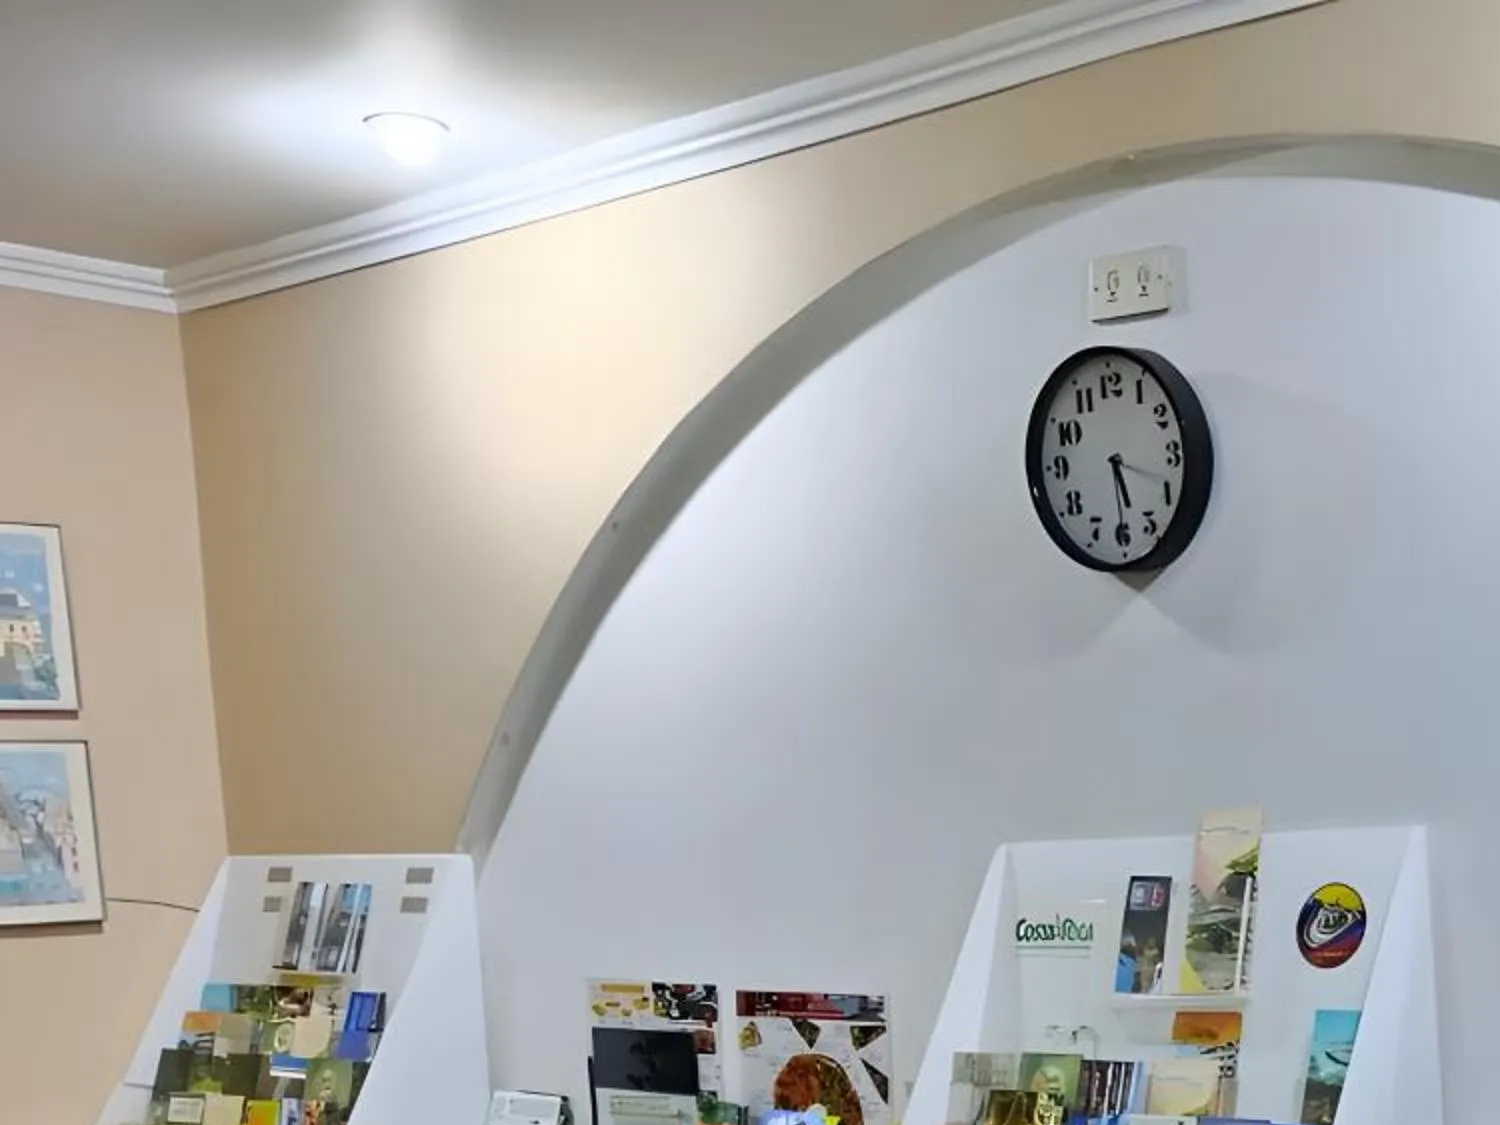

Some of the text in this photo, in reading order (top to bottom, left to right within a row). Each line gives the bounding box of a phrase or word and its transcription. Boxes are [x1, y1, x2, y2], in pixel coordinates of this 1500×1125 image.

[1100, 372, 1123, 400] 12
[1076, 387, 1093, 414] 11
[1153, 403, 1169, 429] 2
[1058, 420, 1082, 447] 10
[1166, 440, 1182, 467] 3
[1053, 456, 1069, 481] 9
[1066, 490, 1083, 516] 8
[1090, 516, 1102, 541] 7
[1115, 523, 1131, 547] 6
[1142, 511, 1157, 536] 5
